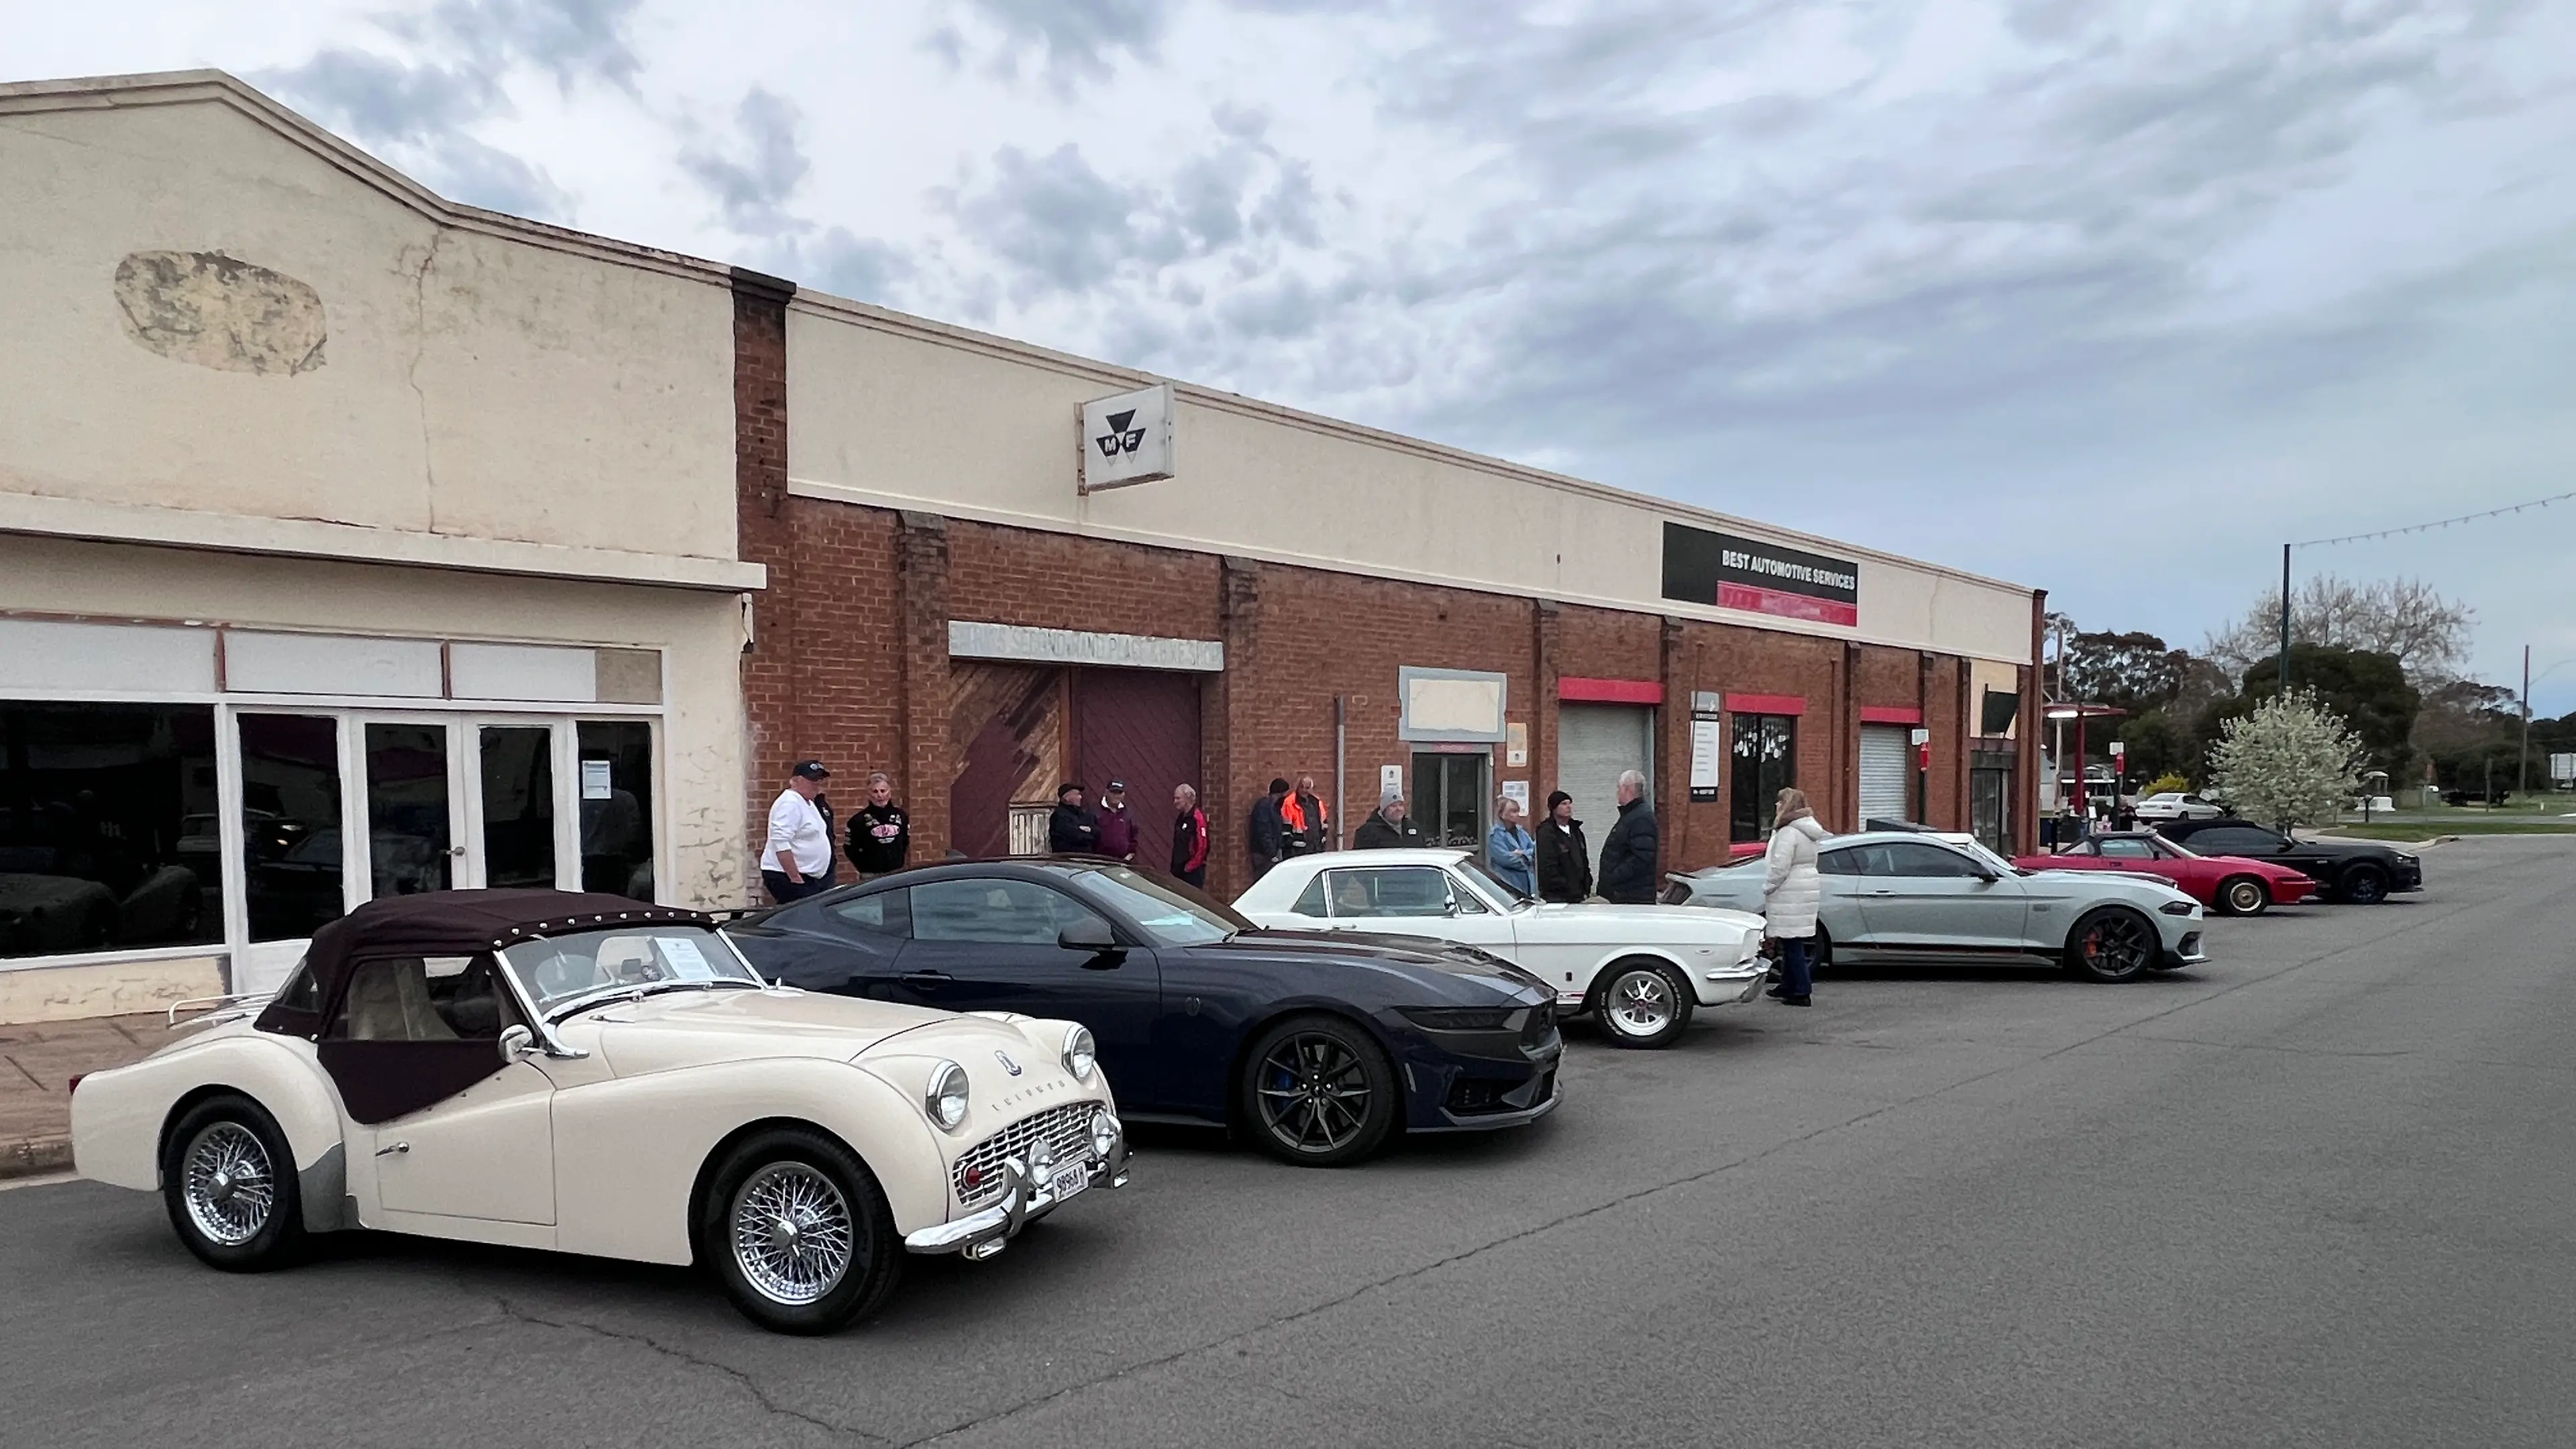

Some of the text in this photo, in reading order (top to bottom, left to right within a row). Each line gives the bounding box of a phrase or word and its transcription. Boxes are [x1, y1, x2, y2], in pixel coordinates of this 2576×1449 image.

[1722, 549, 1856, 590] BEST AUTOMOTIVE SERVICES
